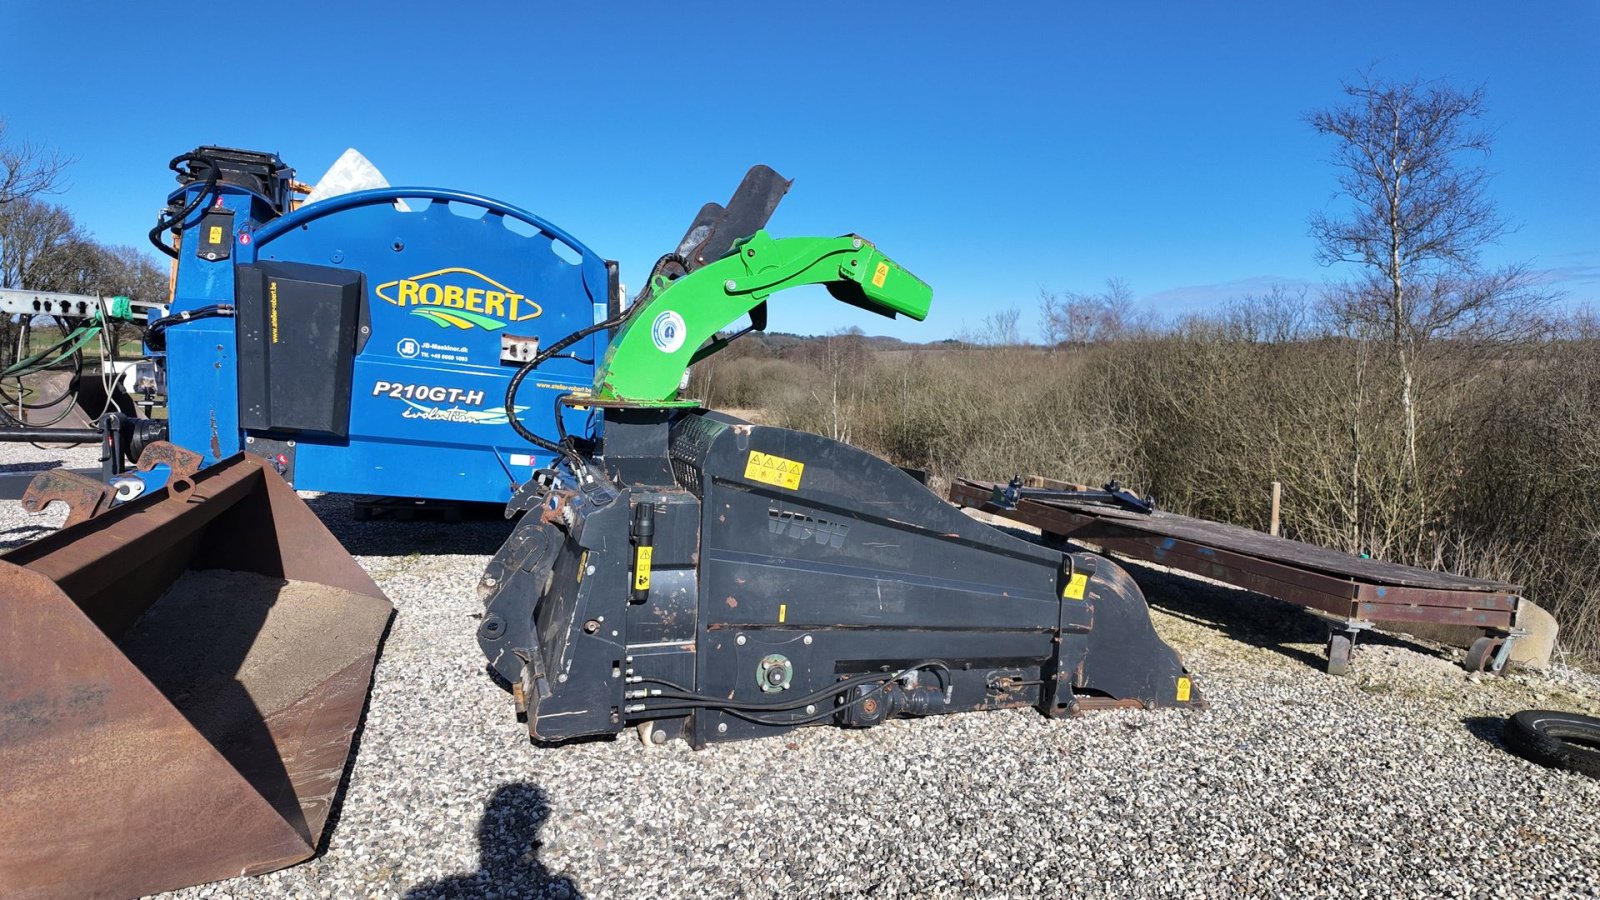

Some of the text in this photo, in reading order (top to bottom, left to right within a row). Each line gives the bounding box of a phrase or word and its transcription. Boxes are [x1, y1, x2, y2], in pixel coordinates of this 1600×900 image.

[398, 279, 524, 321] ROBERT
[402, 343, 414, 354] JB
[373, 382, 484, 404] P210GT-H
